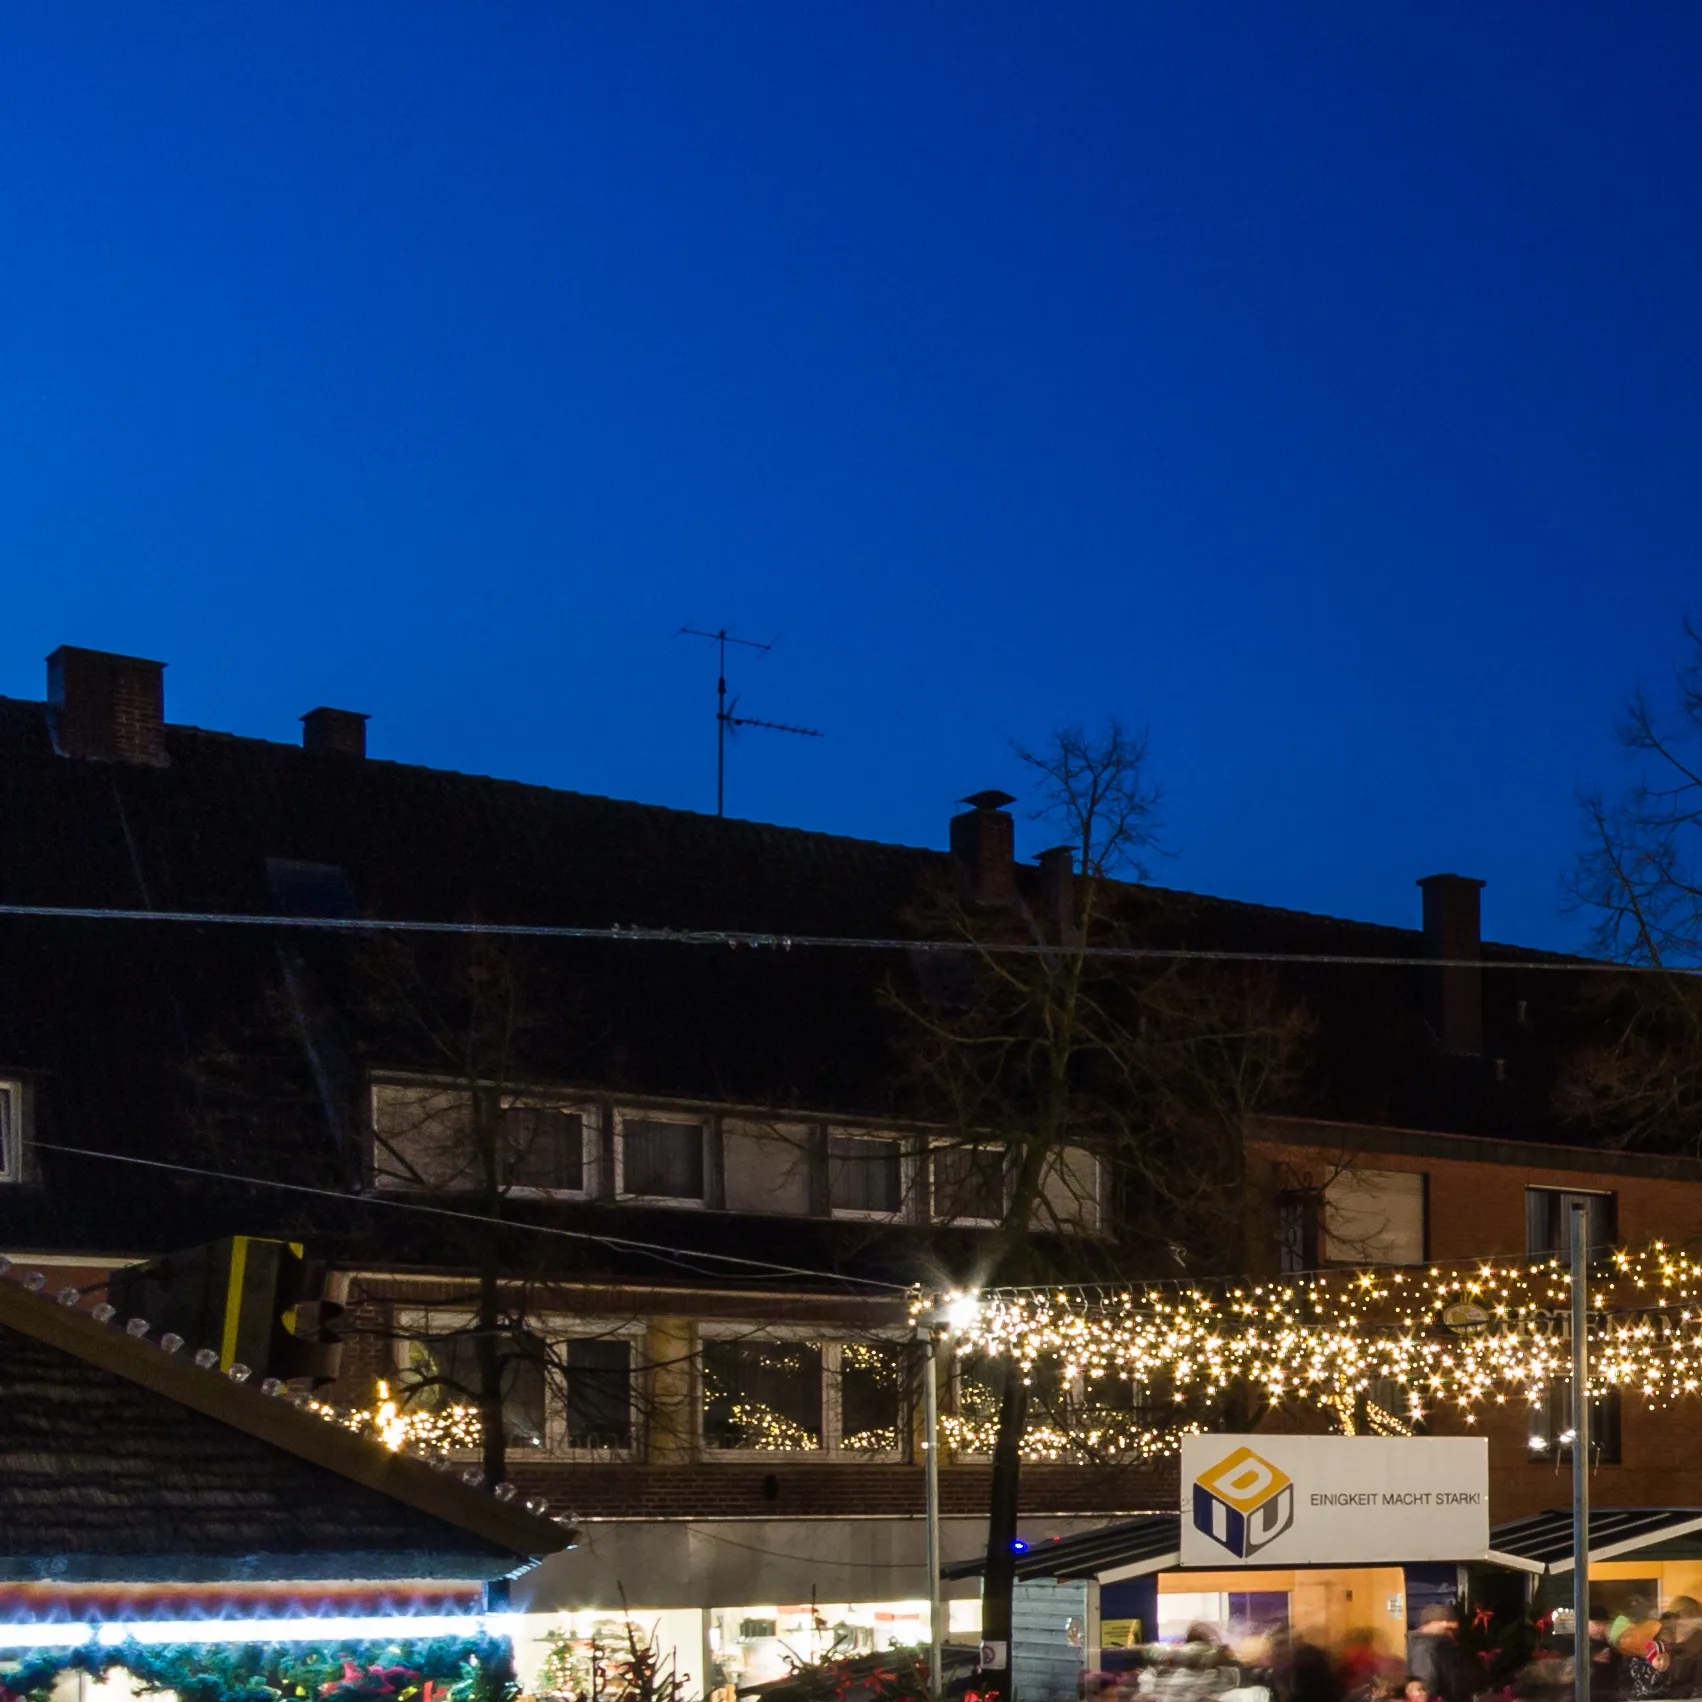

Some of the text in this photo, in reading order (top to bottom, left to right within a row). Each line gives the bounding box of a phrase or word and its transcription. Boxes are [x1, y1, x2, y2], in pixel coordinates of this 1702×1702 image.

[1310, 1492, 1481, 1506] EINIGKEIT MACHT STARK!
